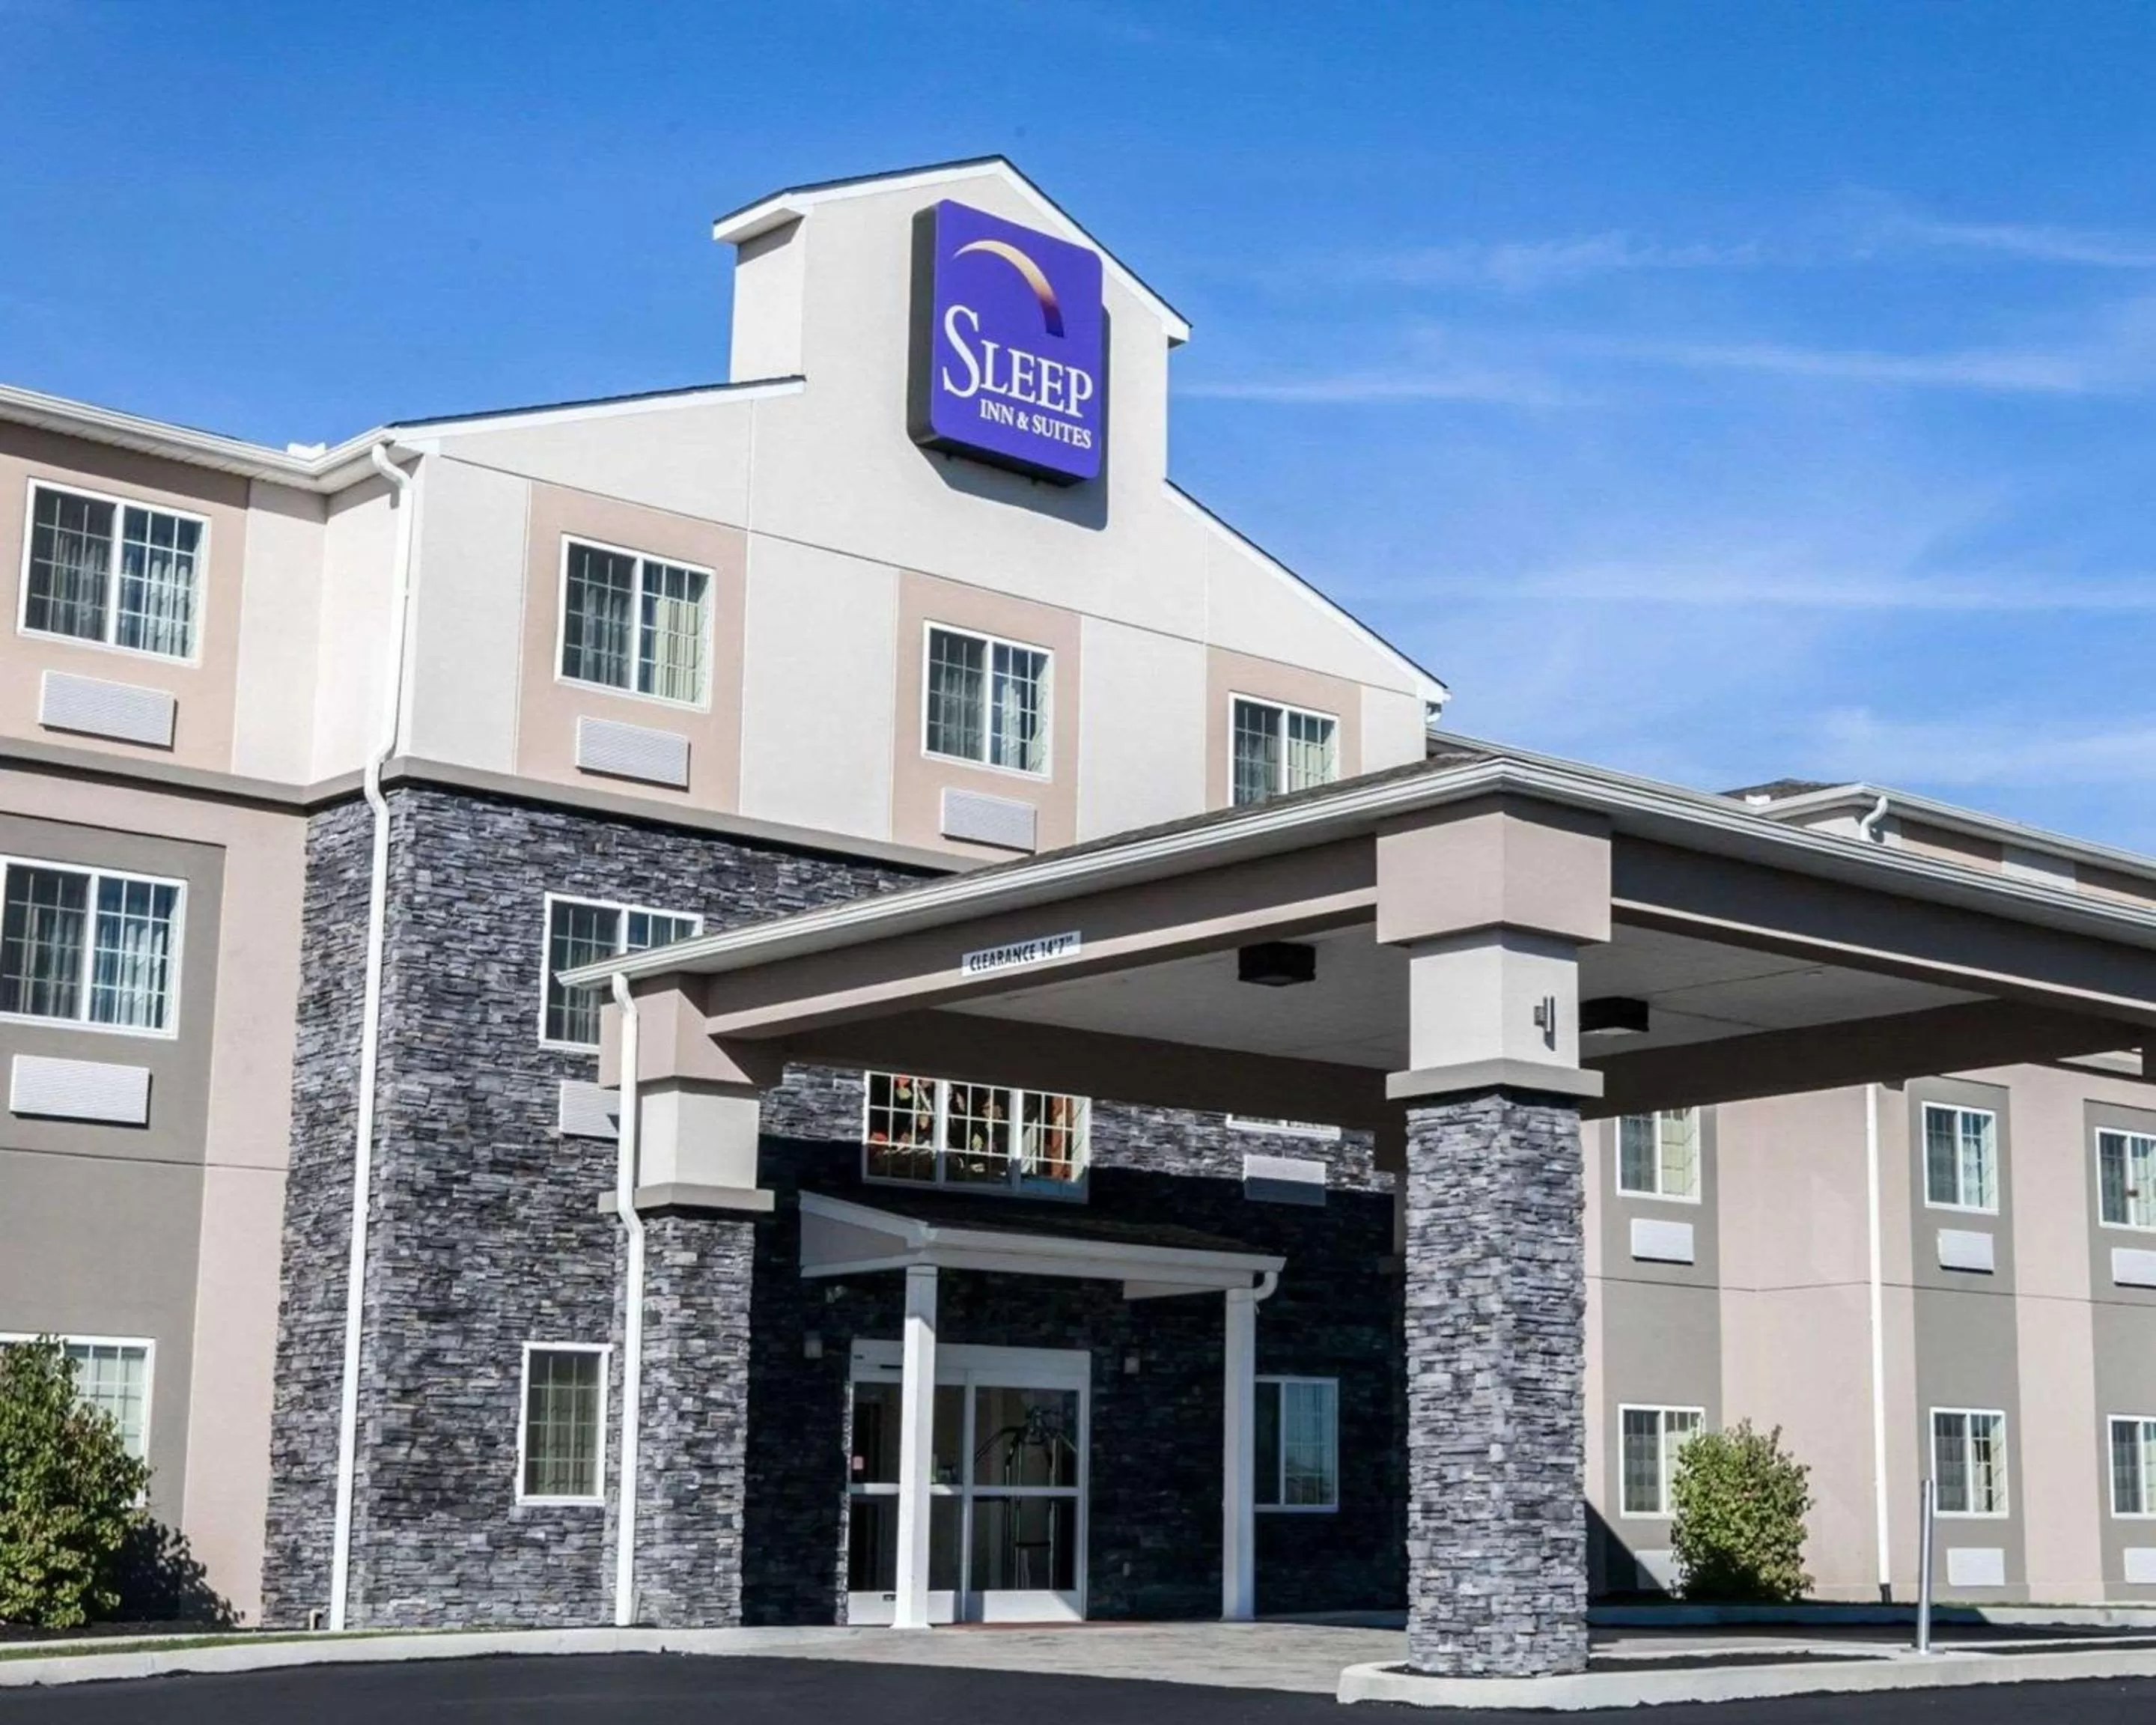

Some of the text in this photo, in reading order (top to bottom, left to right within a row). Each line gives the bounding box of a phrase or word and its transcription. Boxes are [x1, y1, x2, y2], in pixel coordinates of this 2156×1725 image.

[943, 304, 1093, 418] SLEEP
[979, 398, 1091, 448] INN & SUITES
[969, 935, 1074, 971] CLEARANCE 14'7"
